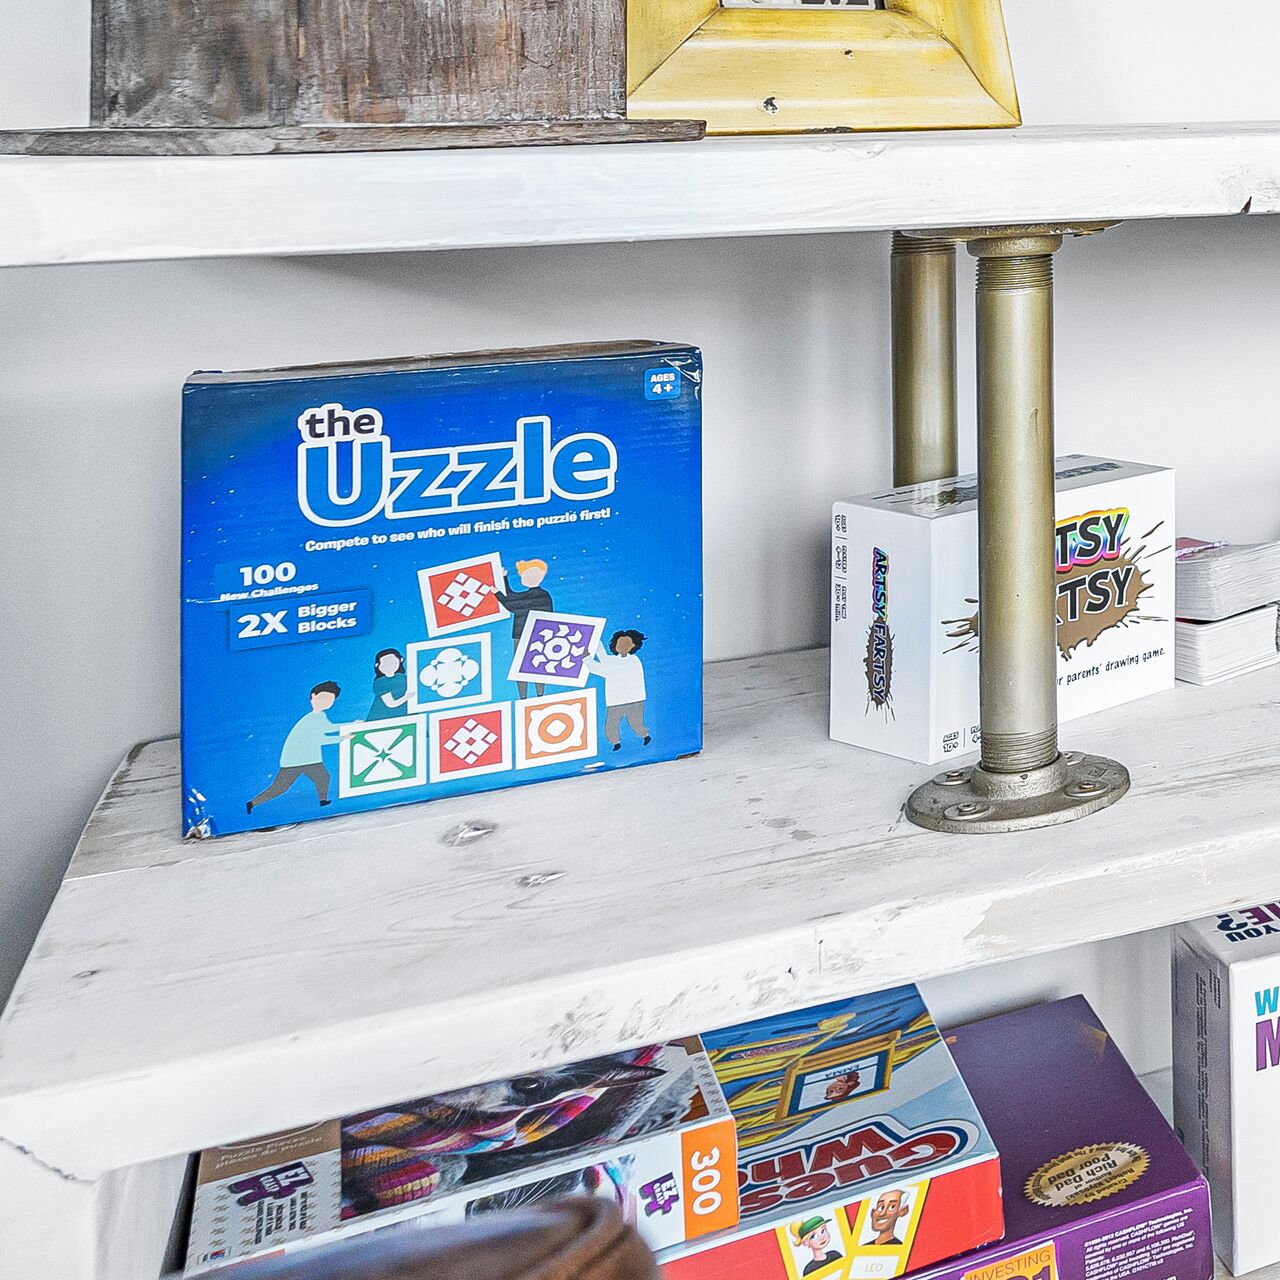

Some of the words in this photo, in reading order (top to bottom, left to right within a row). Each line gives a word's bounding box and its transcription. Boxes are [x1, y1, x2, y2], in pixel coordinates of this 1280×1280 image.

[650, 373, 676, 383] AGES
[305, 407, 376, 441] the
[298, 416, 618, 527] Uzzle
[305, 535, 368, 552] Compete
[372, 533, 388, 545] to
[389, 530, 413, 543] see
[417, 526, 446, 540] who
[448, 523, 471, 536] will
[474, 518, 510, 534] finish
[512, 516, 534, 530] the
[537, 511, 577, 528] puzzle
[580, 508, 611, 521] first!
[1057, 514, 1125, 565] TSY
[240, 562, 296, 586] 100
[873, 546, 889, 620] ARTSY
[251, 583, 319, 598] Challenges
[297, 601, 357, 618] Bigger
[237, 610, 288, 639] 2X
[297, 616, 357, 634] Blocks
[873, 621, 887, 702] FARTSY
[1106, 655, 1139, 671] drawing
[1142, 648, 1165, 662] game.
[1225, 924, 1280, 942] YOU
[824, 1064, 860, 1078] EMMA
[1079, 1153, 1111, 1171] Poor
[1086, 1159, 1118, 1177] Rich
[691, 1147, 722, 1215] 300
[740, 1132, 956, 1215] Gues
[1047, 1168, 1076, 1185] Dad
[1055, 1175, 1084, 1192] Dad
[865, 1263, 883, 1273] LEO
